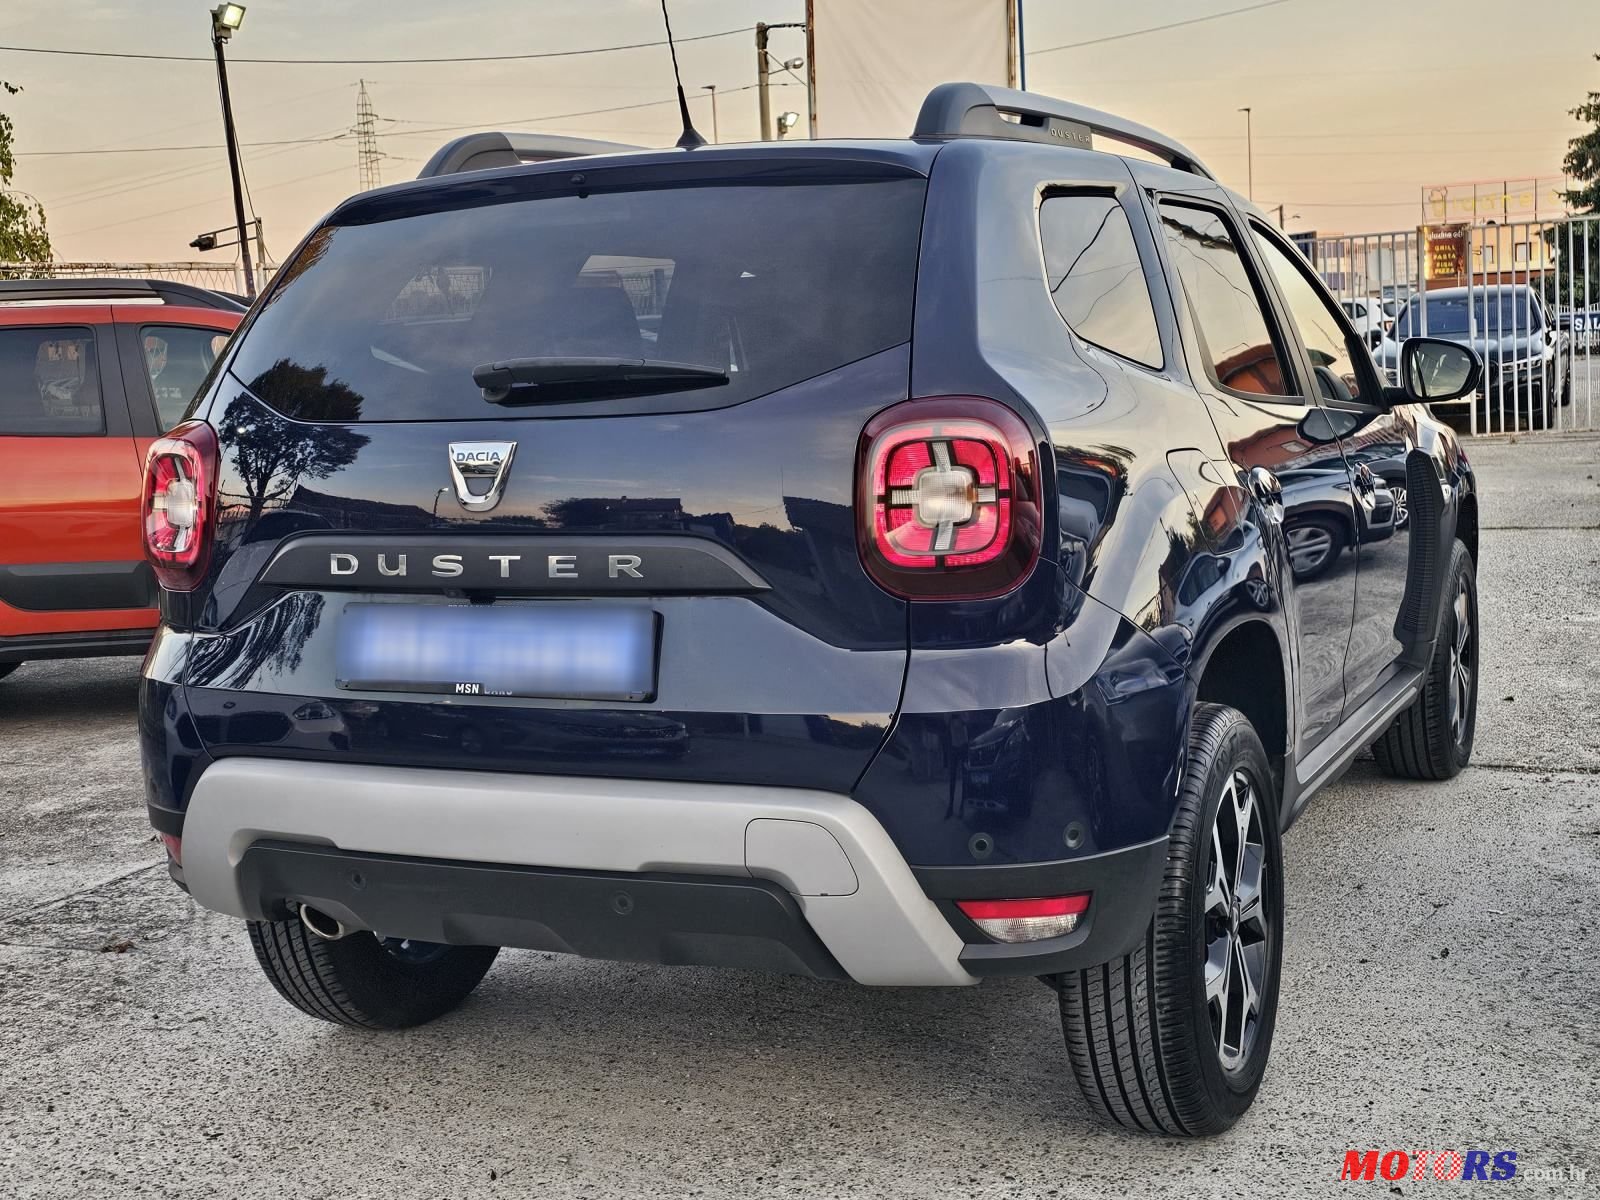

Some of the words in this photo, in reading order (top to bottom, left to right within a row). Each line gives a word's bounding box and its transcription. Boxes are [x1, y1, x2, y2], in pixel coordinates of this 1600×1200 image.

[1051, 128, 1090, 142] DUSTER
[457, 452, 500, 461] DACIA
[330, 553, 644, 578] DUSTER
[455, 683, 479, 694] MSN
